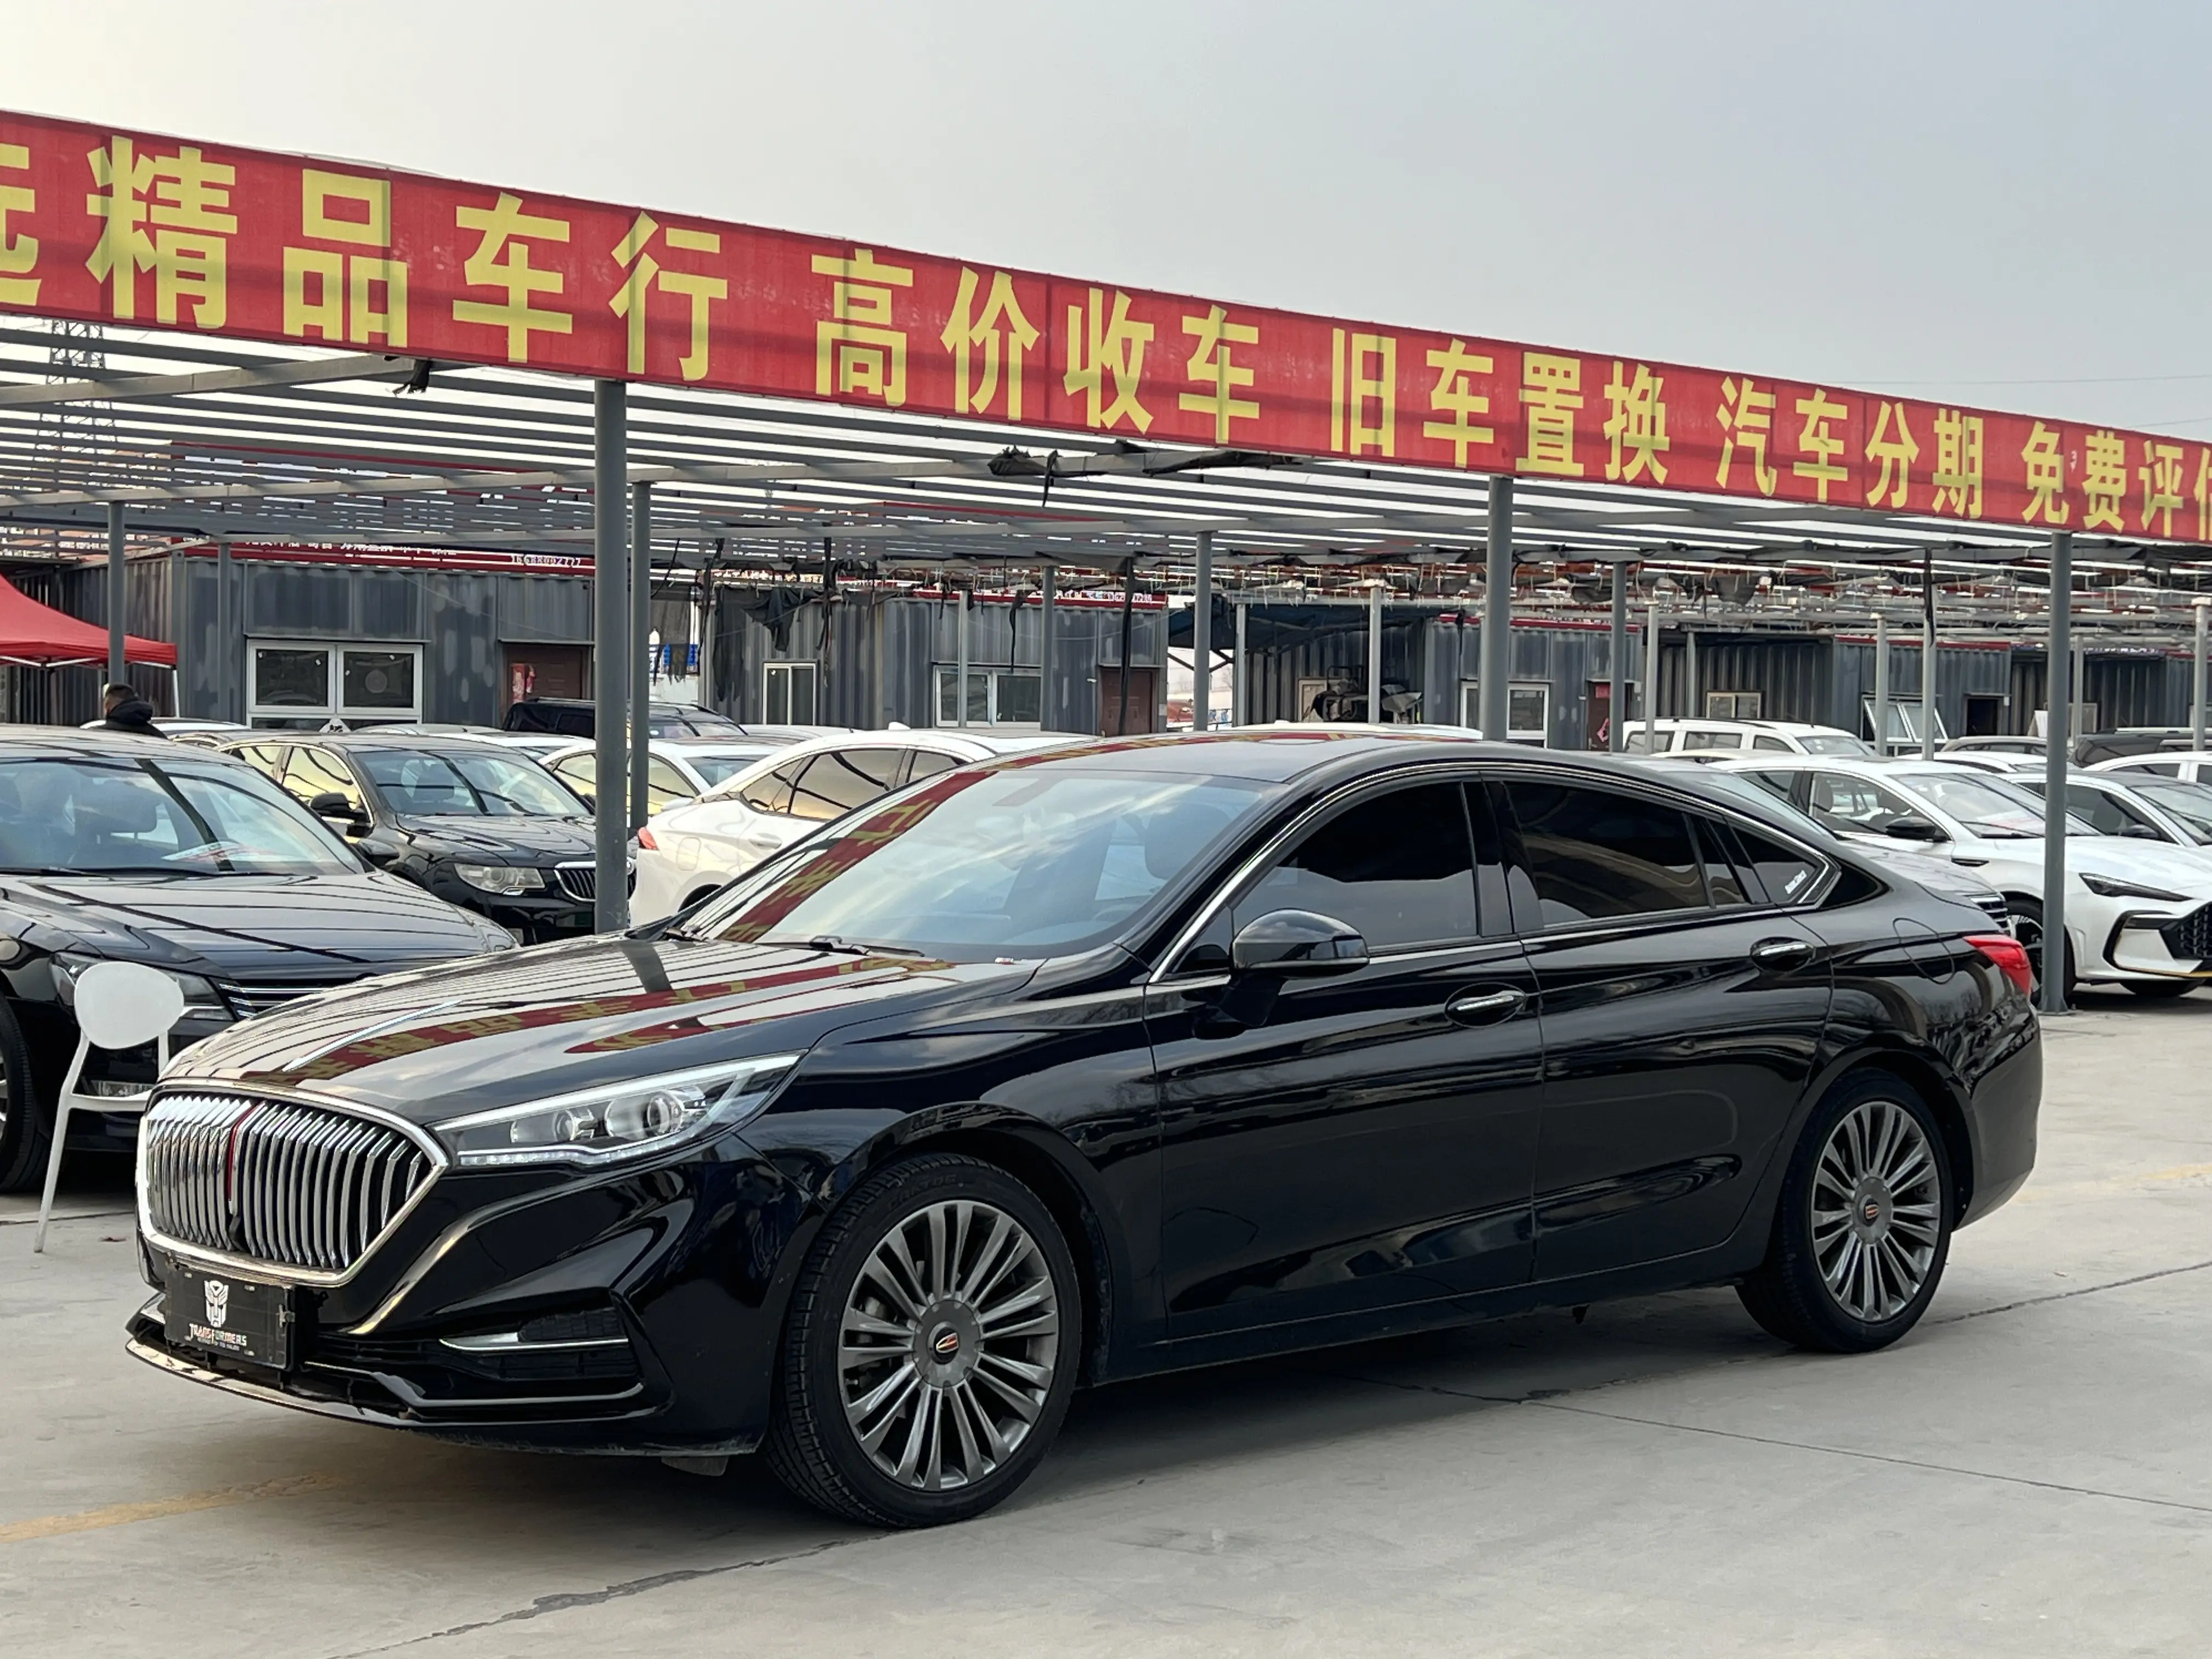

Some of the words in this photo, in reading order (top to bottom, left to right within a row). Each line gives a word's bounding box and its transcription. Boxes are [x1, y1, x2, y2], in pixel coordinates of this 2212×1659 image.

[0, 139, 727, 380] 精品车行
[811, 249, 1260, 445] 高价收车
[1330, 328, 1671, 485] 旧车置换
[1716, 376, 1983, 518] 汽车分期
